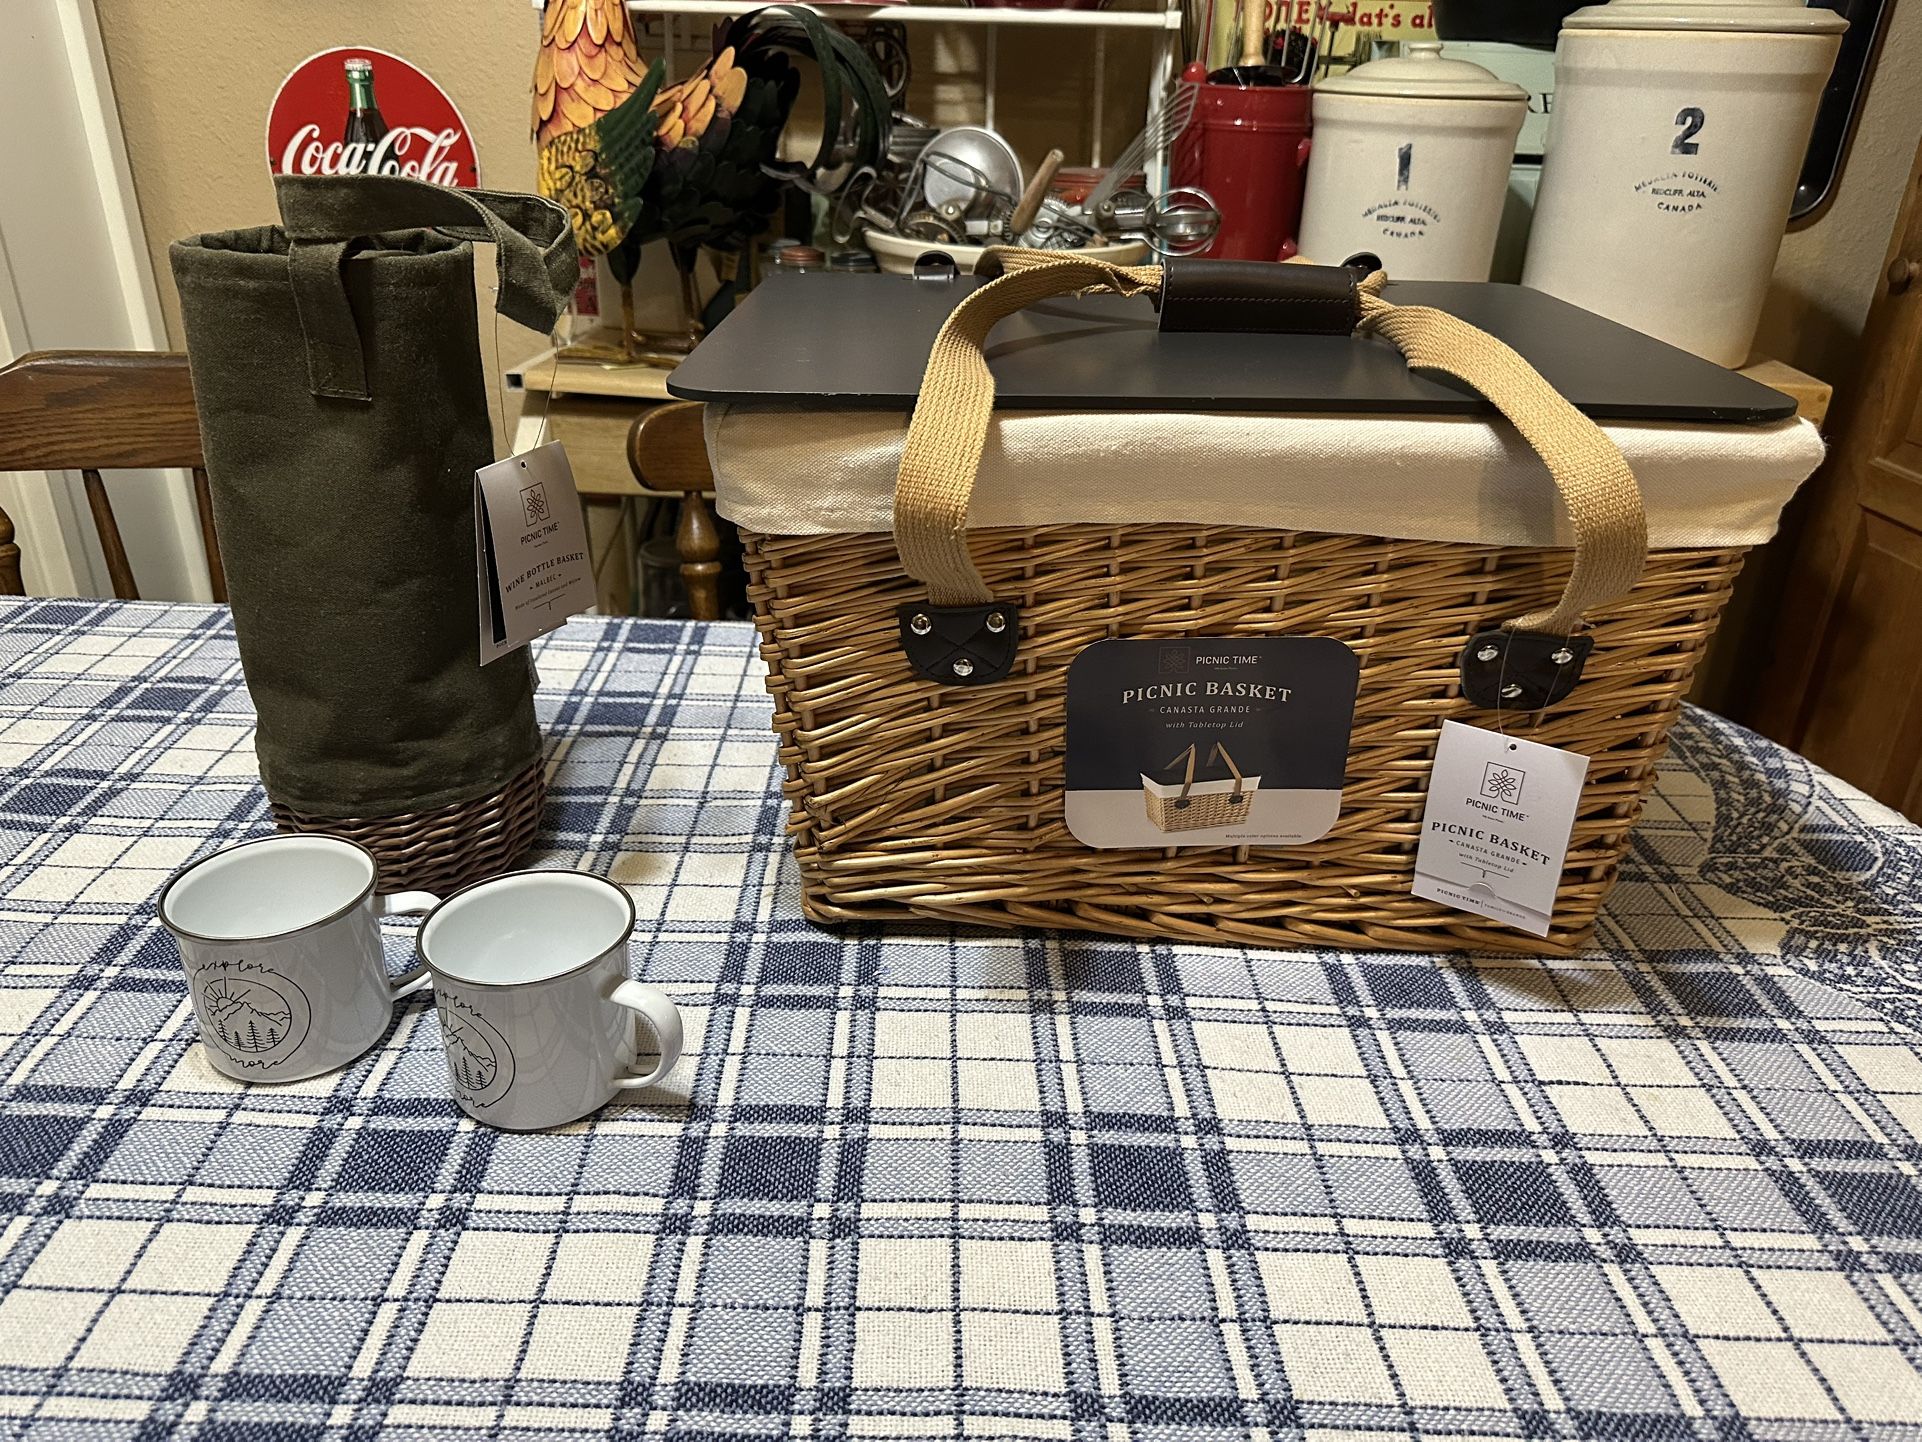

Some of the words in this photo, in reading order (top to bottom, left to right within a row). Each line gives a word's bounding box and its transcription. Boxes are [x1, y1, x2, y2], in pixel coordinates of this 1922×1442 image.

[1670, 107, 1705, 155] 2
[282, 124, 462, 187] Coca-Cola
[1397, 143, 1412, 191] 1
[1657, 202, 1703, 212] CANADA
[521, 529, 541, 545] PICNIC
[543, 522, 558, 536] TIME
[505, 574, 525, 593] WINE
[526, 558, 555, 579] BOTTLE
[556, 552, 584, 565] BASKET
[535, 574, 556, 588] MALBEC
[1196, 655, 1230, 665] PICNIC
[1232, 655, 1258, 665] TIME
[1122, 682, 1197, 705] PICNIC
[1206, 681, 1292, 703] BASKET
[1159, 706, 1205, 714] CANASTA
[1209, 705, 1251, 714] GRANDE
[1165, 721, 1185, 729] with
[1188, 721, 1227, 730] Tabletop
[1229, 721, 1244, 729] Lid
[1466, 797, 1498, 814] PICNIC
[1501, 808, 1526, 822] TIME
[1431, 821, 1485, 840] PICNIC
[1490, 833, 1550, 866] BASKET
[1456, 840, 1488, 855] CANASTA
[1490, 851, 1520, 865] GRANDE
[1459, 852, 1473, 860] with
[1475, 856, 1502, 870] Tabletop
[1503, 865, 1515, 873] Lid
[1436, 887, 1461, 899] PICNIC
[200, 959, 276, 974] explore
[229, 1055, 282, 1070] more
